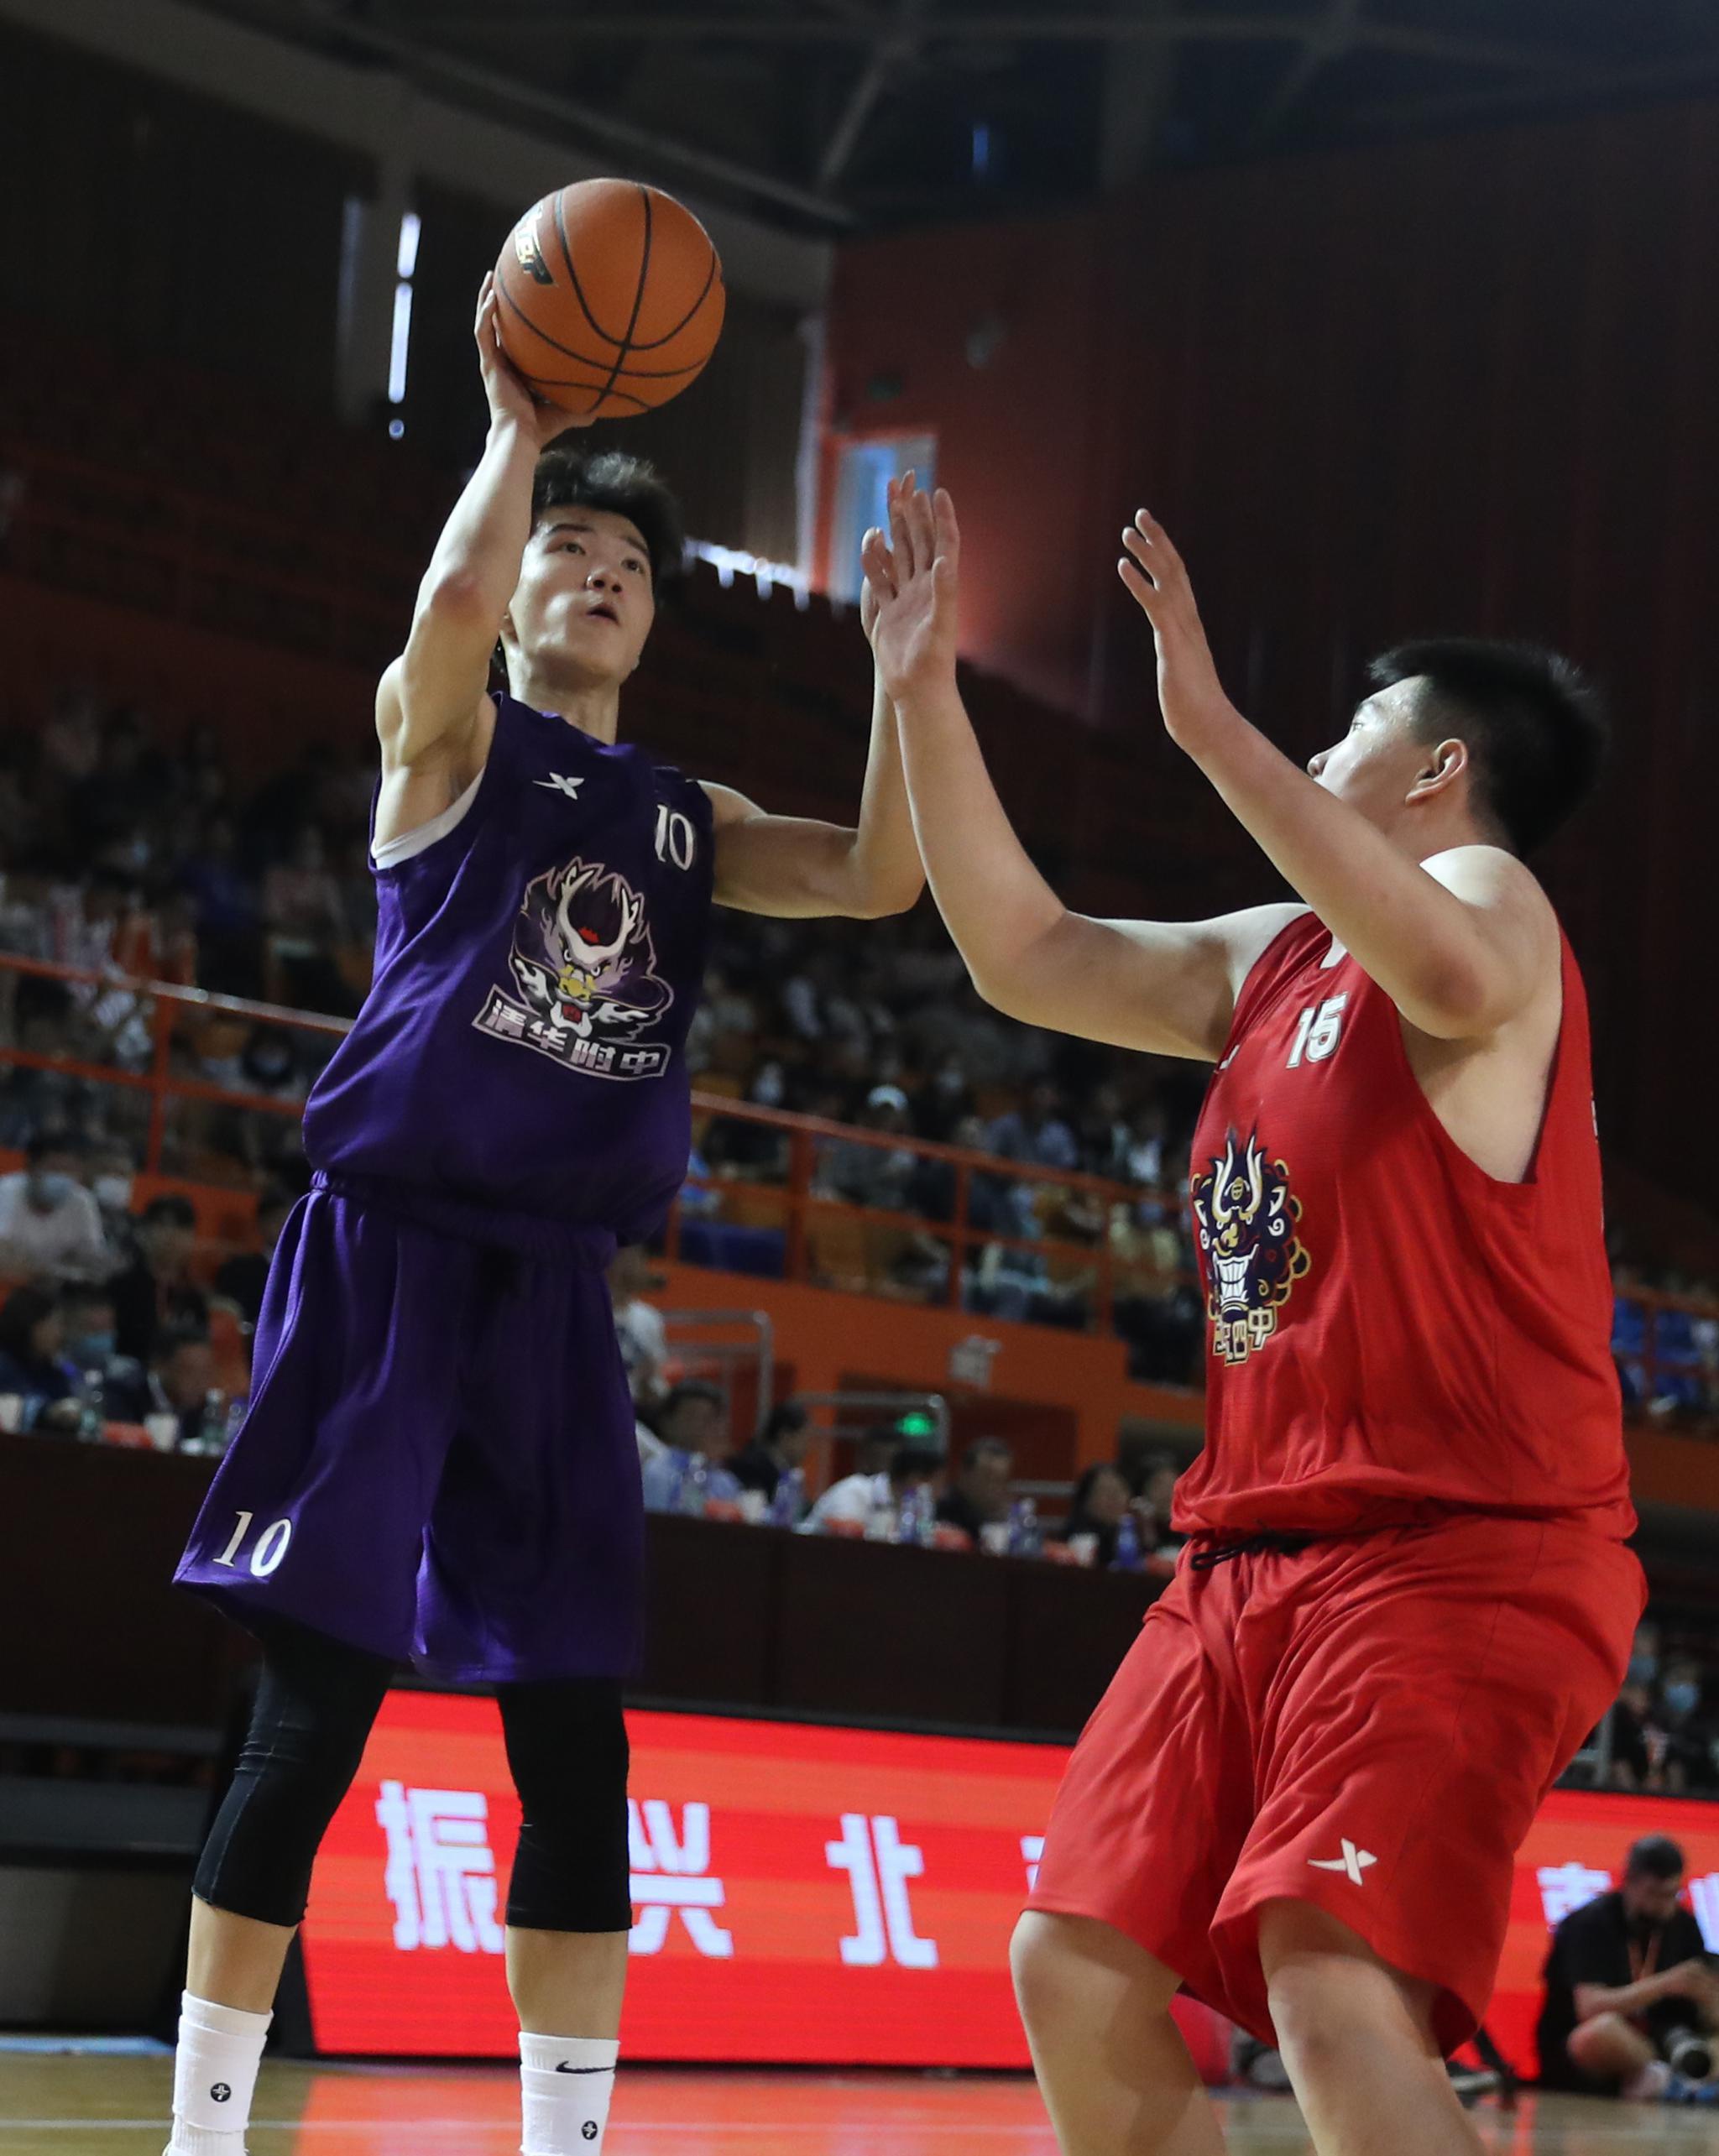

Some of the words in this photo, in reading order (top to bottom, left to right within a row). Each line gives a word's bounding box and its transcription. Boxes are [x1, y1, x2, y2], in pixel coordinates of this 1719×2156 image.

[655, 803, 694, 871] 10
[484, 998, 661, 1075] 清华附中
[1285, 991, 1349, 1069] 15
[212, 1511, 292, 1578] 10
